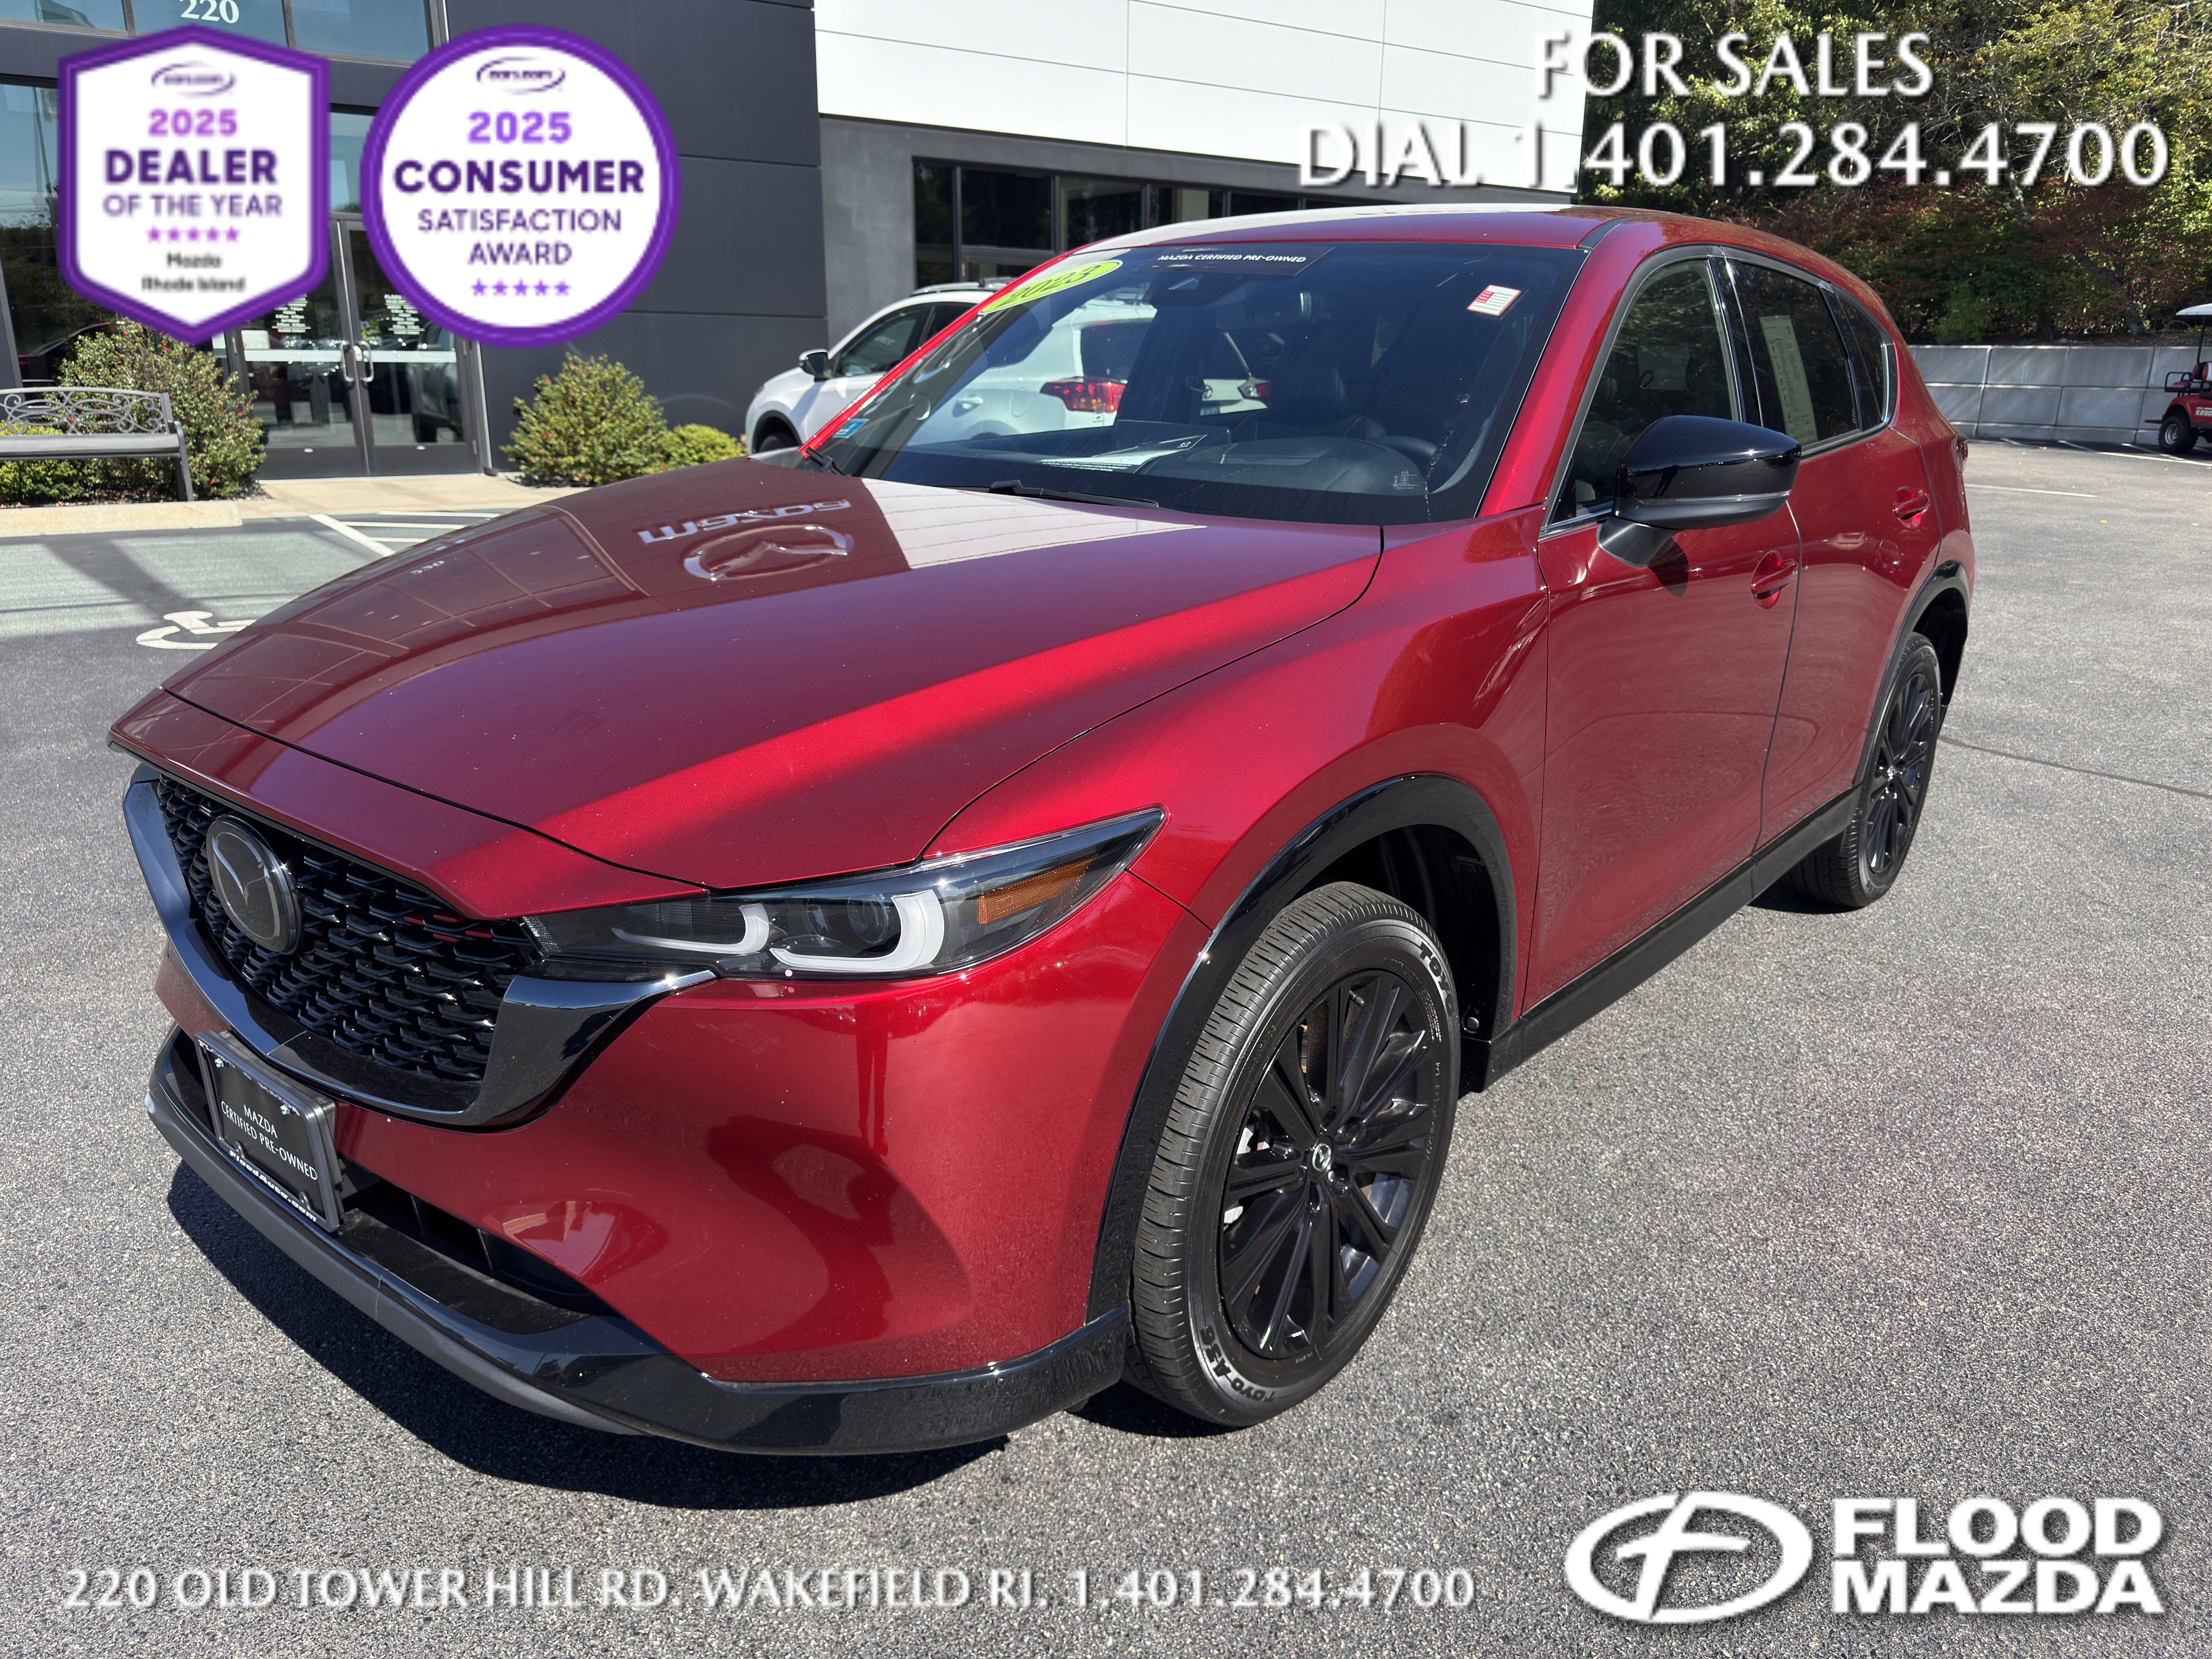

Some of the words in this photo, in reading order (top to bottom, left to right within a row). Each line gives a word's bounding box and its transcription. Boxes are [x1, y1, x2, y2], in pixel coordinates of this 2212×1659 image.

[179, 0, 239, 23] 220
[1243, 254, 1306, 263] PRE-OWNED
[996, 265, 1101, 308] 2023
[1420, 942, 1454, 1017] TOYO
[221, 1101, 257, 1139] CERTIFIED
[260, 1132, 318, 1181] PRE-OWNED
[244, 1104, 278, 1139] MAZDA
[229, 1150, 317, 1222] FloodAuto.com
